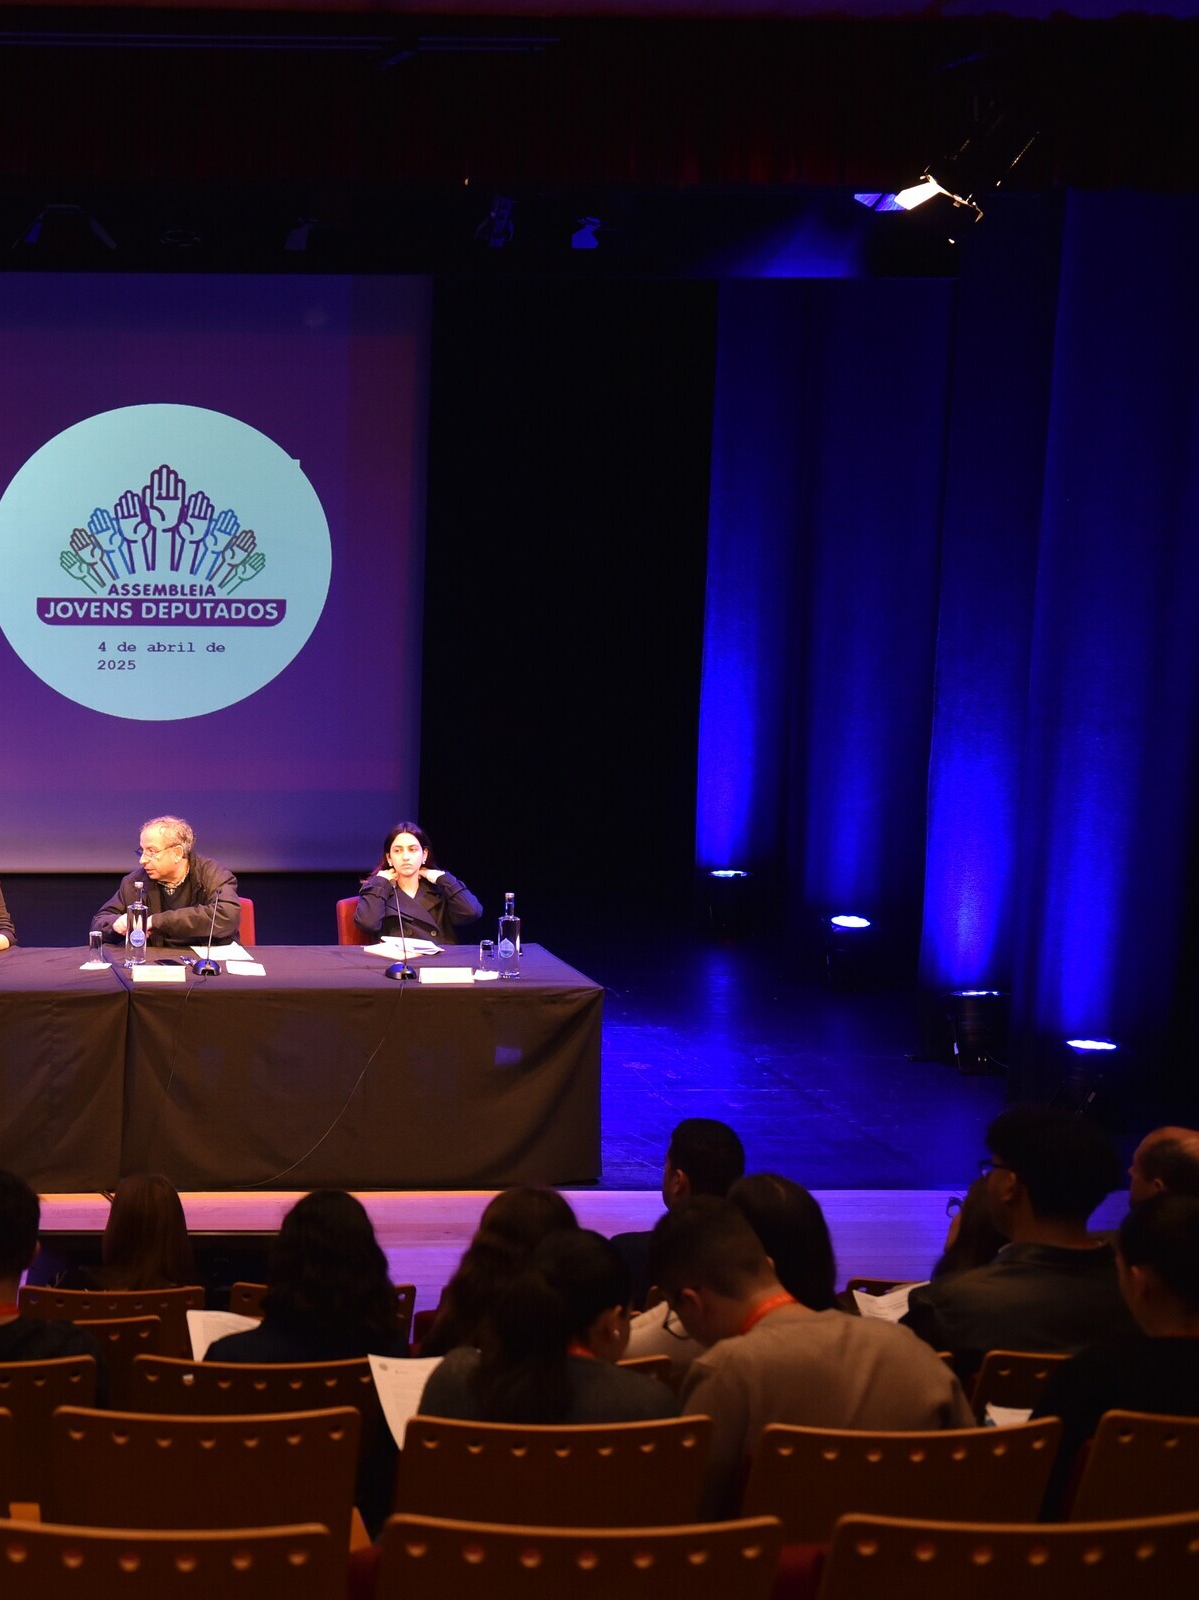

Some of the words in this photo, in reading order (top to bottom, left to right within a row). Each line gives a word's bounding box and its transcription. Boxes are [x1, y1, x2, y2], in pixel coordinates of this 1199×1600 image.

[107, 583, 217, 597] ASSEMBLEIA
[44, 602, 133, 619] JOVENS
[141, 602, 279, 620] DEPUTADOS
[97, 641, 107, 653] 4
[116, 641, 137, 653] de
[146, 641, 196, 653] abril
[205, 642, 226, 653] de
[97, 659, 137, 671] 2025
